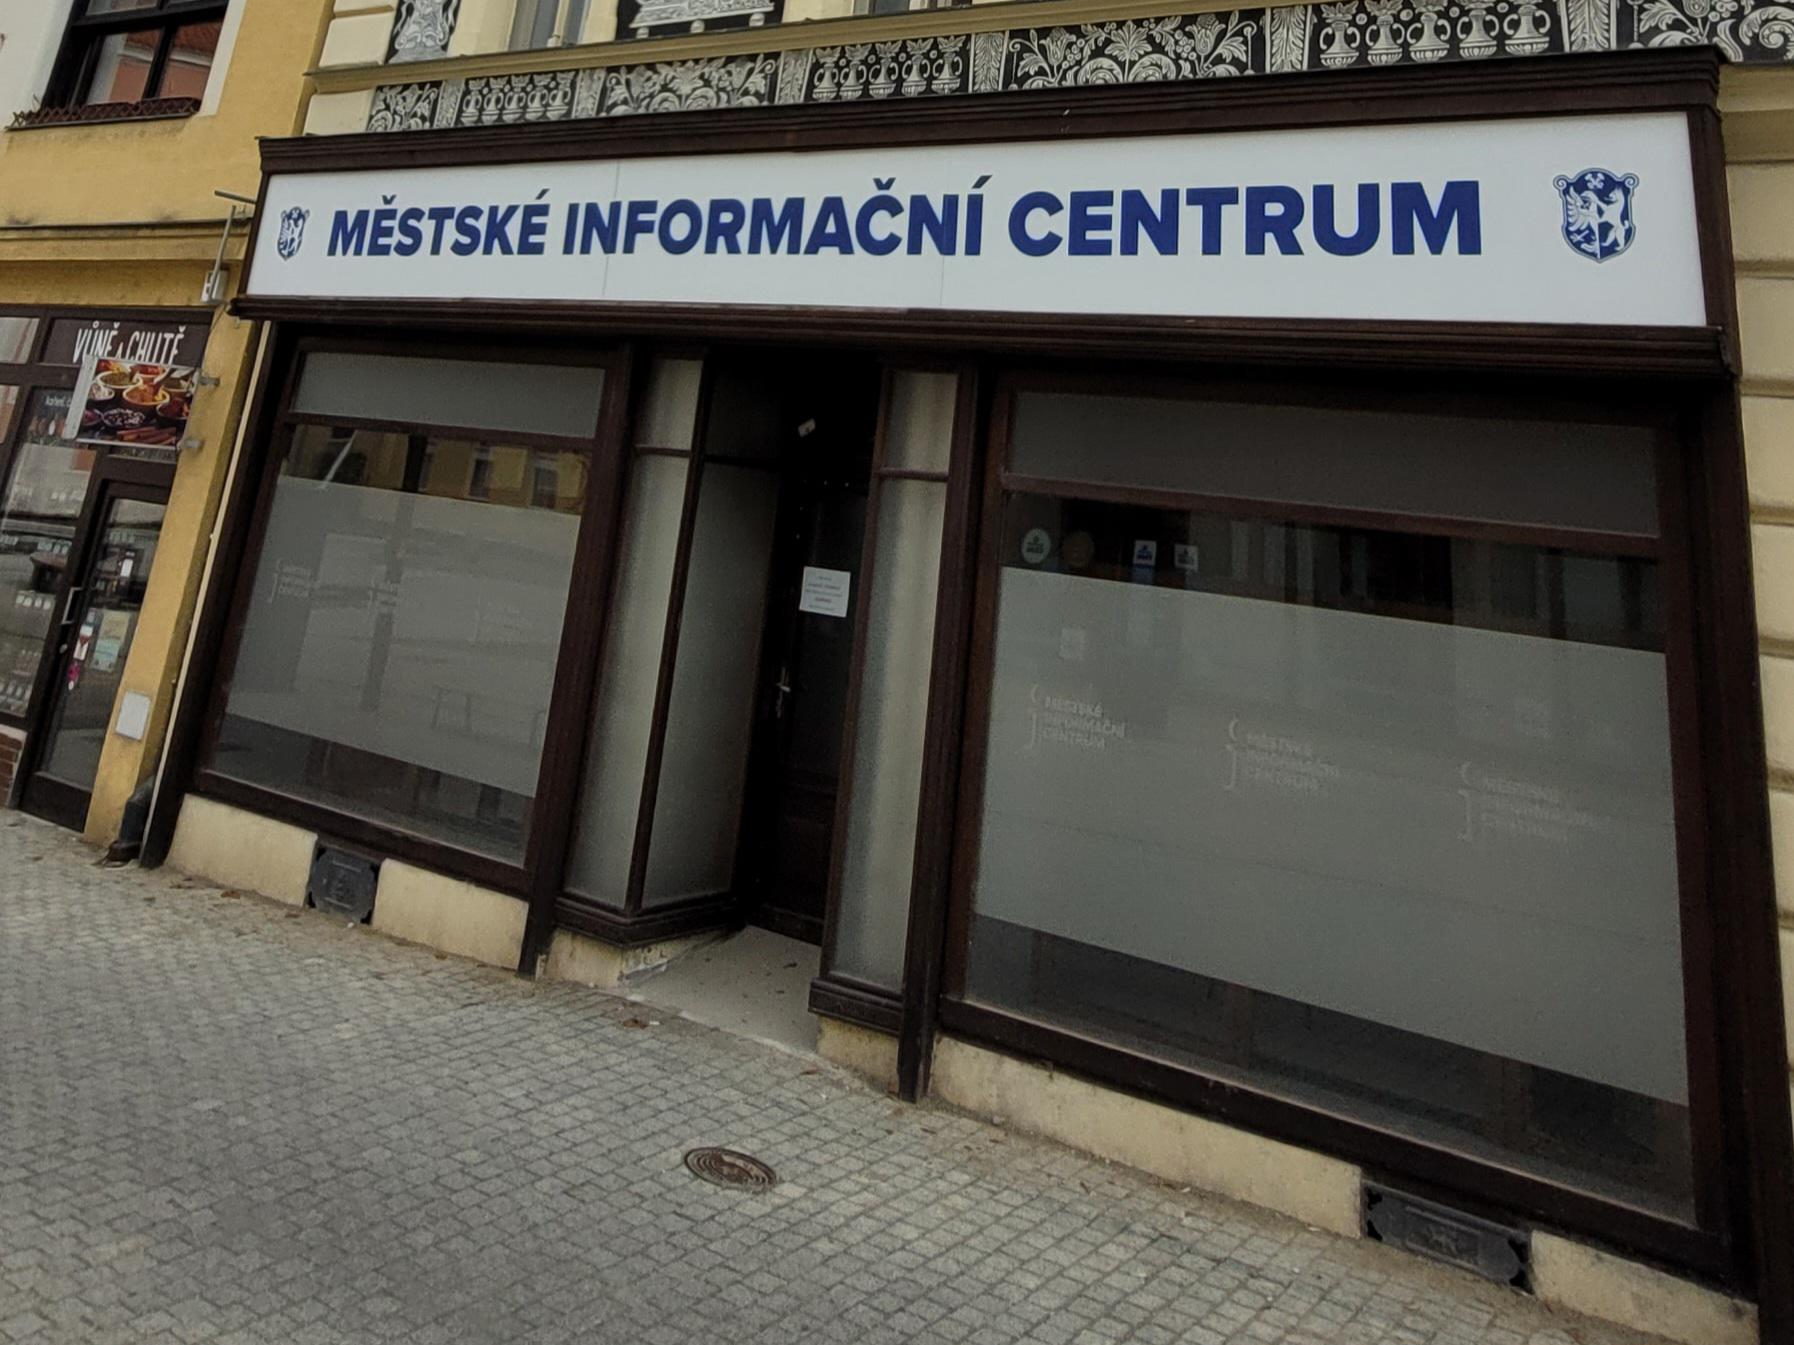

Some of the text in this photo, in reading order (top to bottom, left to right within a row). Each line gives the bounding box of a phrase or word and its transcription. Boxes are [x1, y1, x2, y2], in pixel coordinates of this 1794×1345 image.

[327, 175, 1482, 257] MĚSTSKÉ INFORMAČNÍ CENTRUM
[73, 320, 120, 363] VŮNĚ
[125, 325, 185, 365] CHUTĚ
